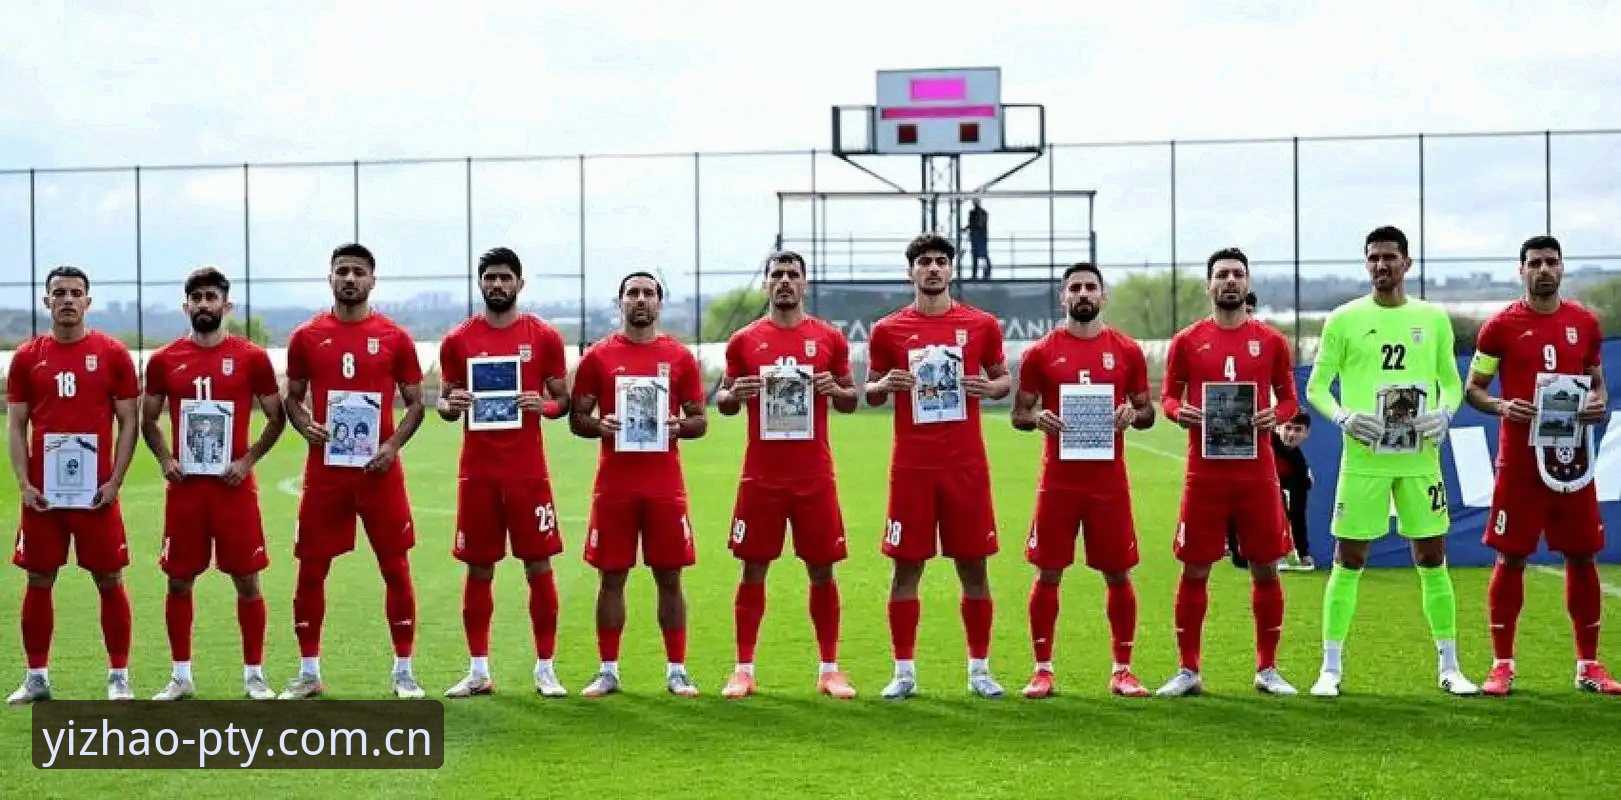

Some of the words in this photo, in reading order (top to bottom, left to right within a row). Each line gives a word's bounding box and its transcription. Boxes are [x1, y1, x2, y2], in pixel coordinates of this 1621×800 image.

[342, 352, 355, 378] 8
[1224, 355, 1236, 381] 4
[1381, 344, 1406, 371] 22
[1543, 344, 1557, 370] 9
[55, 371, 77, 398] 18
[192, 376, 212, 401] 11
[1494, 510, 1507, 536] 9
